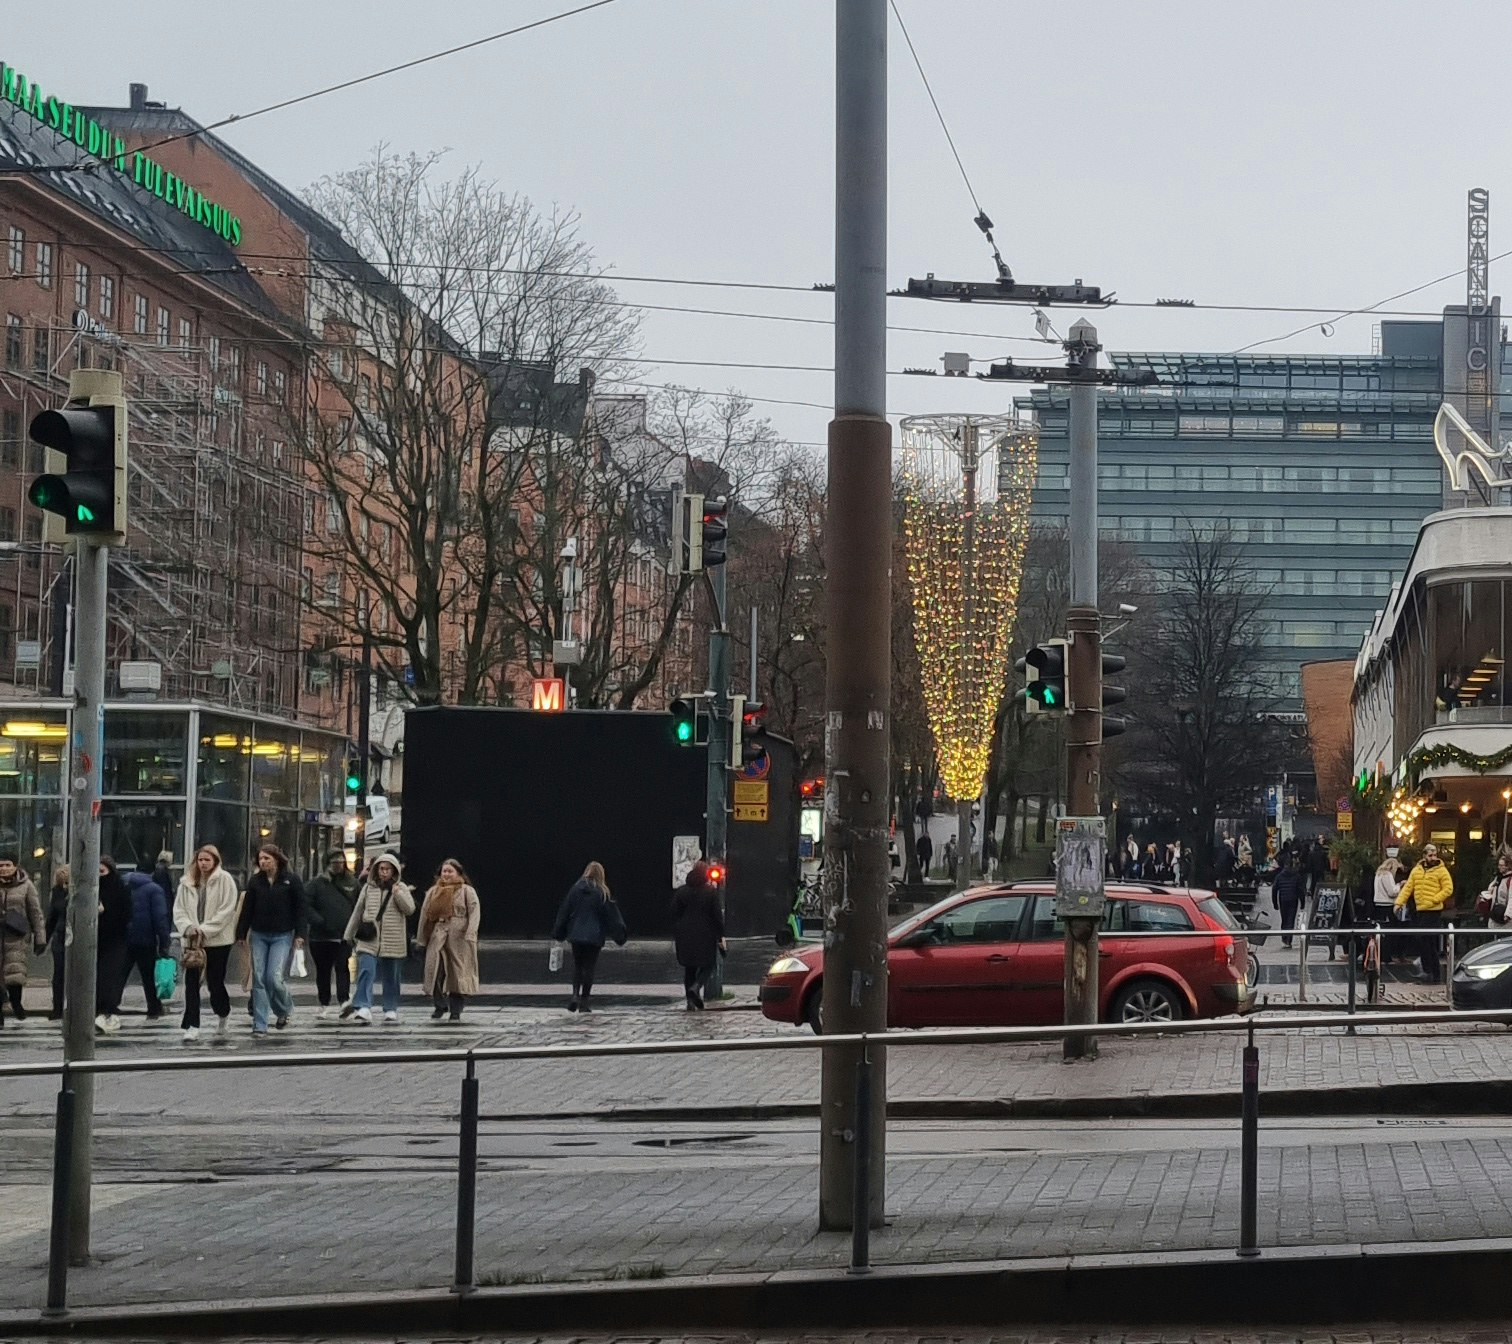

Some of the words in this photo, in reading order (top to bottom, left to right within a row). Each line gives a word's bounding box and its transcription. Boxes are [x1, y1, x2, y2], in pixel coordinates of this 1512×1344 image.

[0, 61, 126, 173] MAASEUDUN
[133, 152, 242, 246] TULEVAISUUS
[1467, 187, 1488, 372] SCANDIC
[533, 682, 560, 710] M
